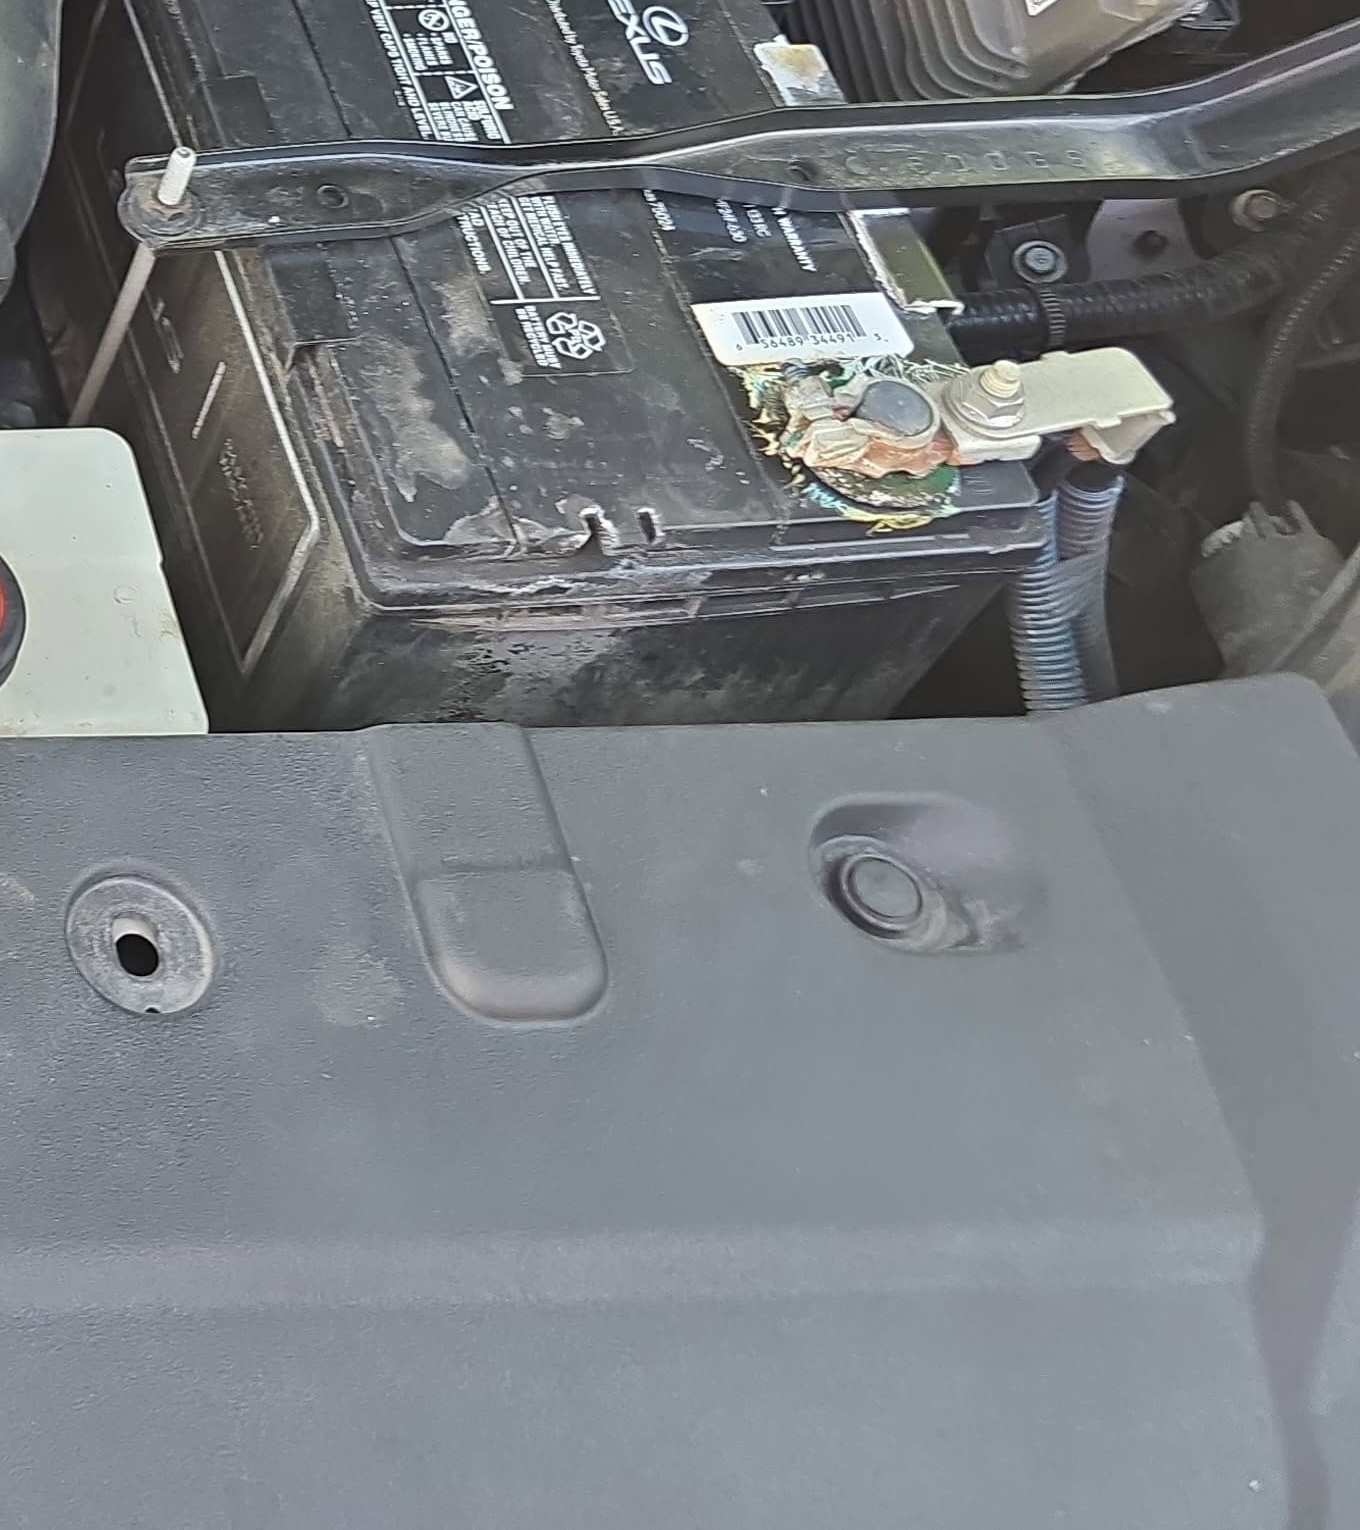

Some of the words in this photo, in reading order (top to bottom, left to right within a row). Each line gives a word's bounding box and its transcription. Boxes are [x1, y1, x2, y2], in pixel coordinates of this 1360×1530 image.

[777, 217, 817, 272] WARRANTY
[760, 334, 805, 349] 56489
[812, 331, 856, 346] 34491
